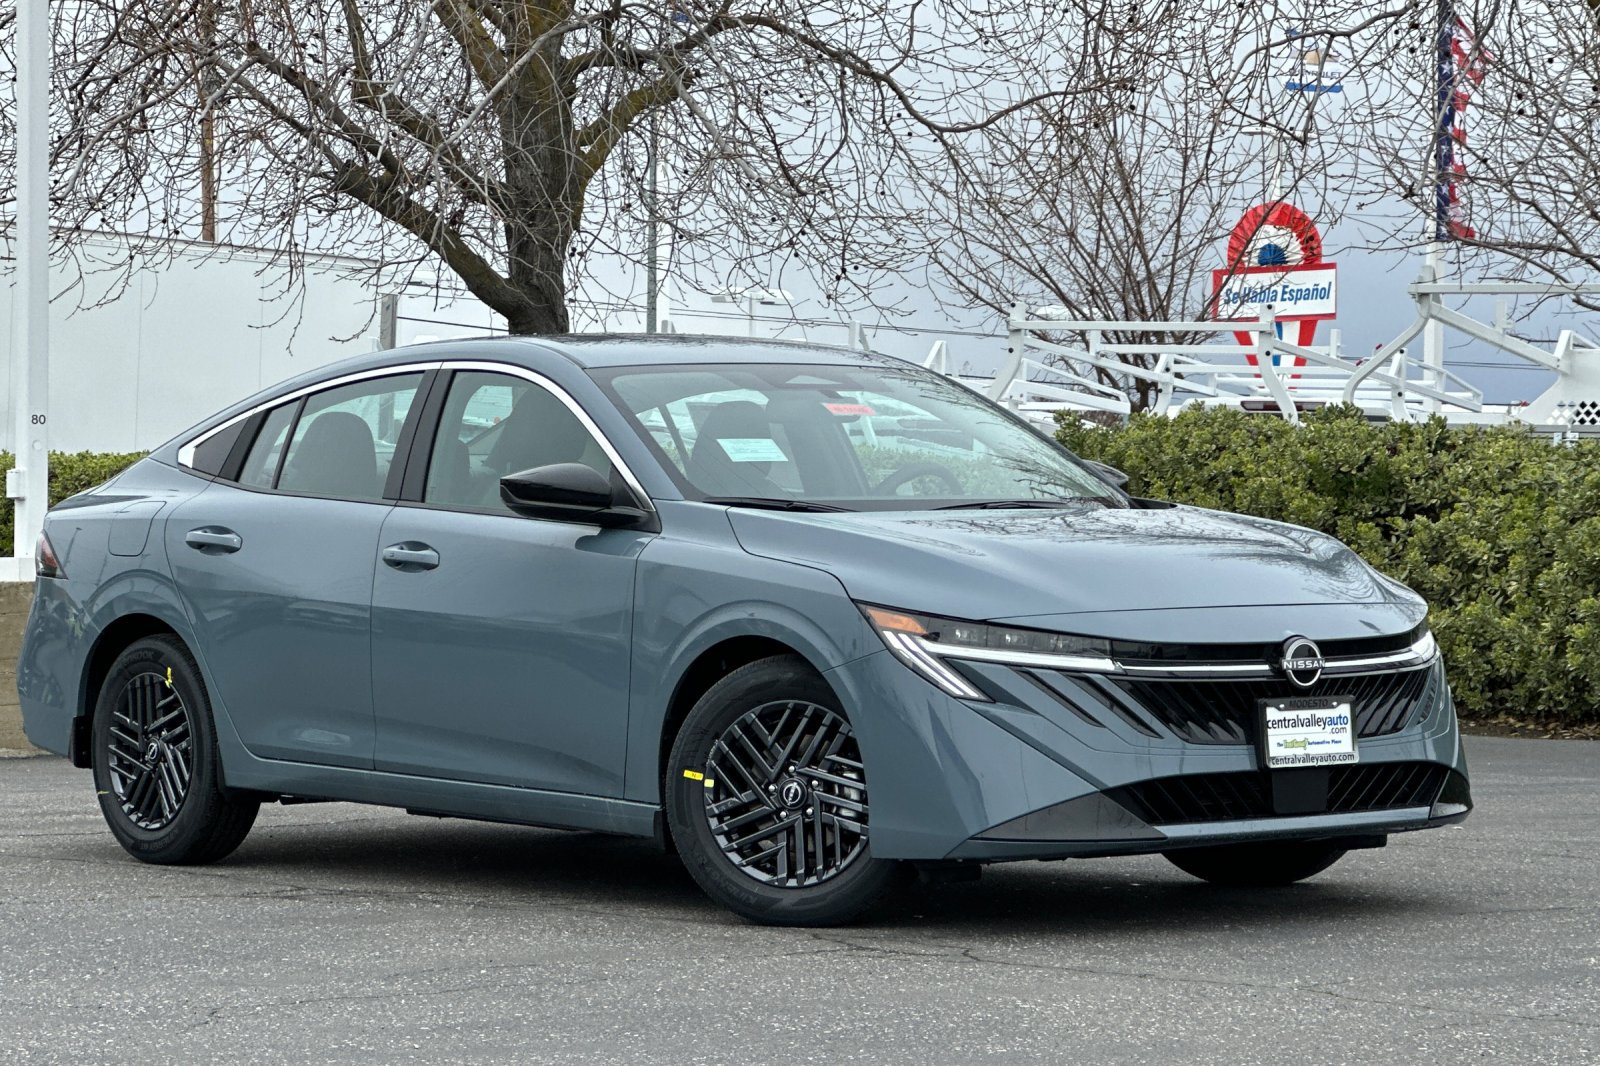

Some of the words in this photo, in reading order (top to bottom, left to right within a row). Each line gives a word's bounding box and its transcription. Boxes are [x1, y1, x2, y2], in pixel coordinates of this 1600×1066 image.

[1224, 287, 1240, 304] Se
[1242, 284, 1278, 303] Habla
[1280, 281, 1332, 305] Español
[31, 414, 46, 425] 80
[1283, 660, 1325, 670] NISSAN
[1289, 699, 1328, 709] MODESTO
[1267, 713, 1349, 731] centralvalleyauto
[1328, 726, 1347, 735] .com
[1271, 752, 1355, 766] centralvalleyauto.com
